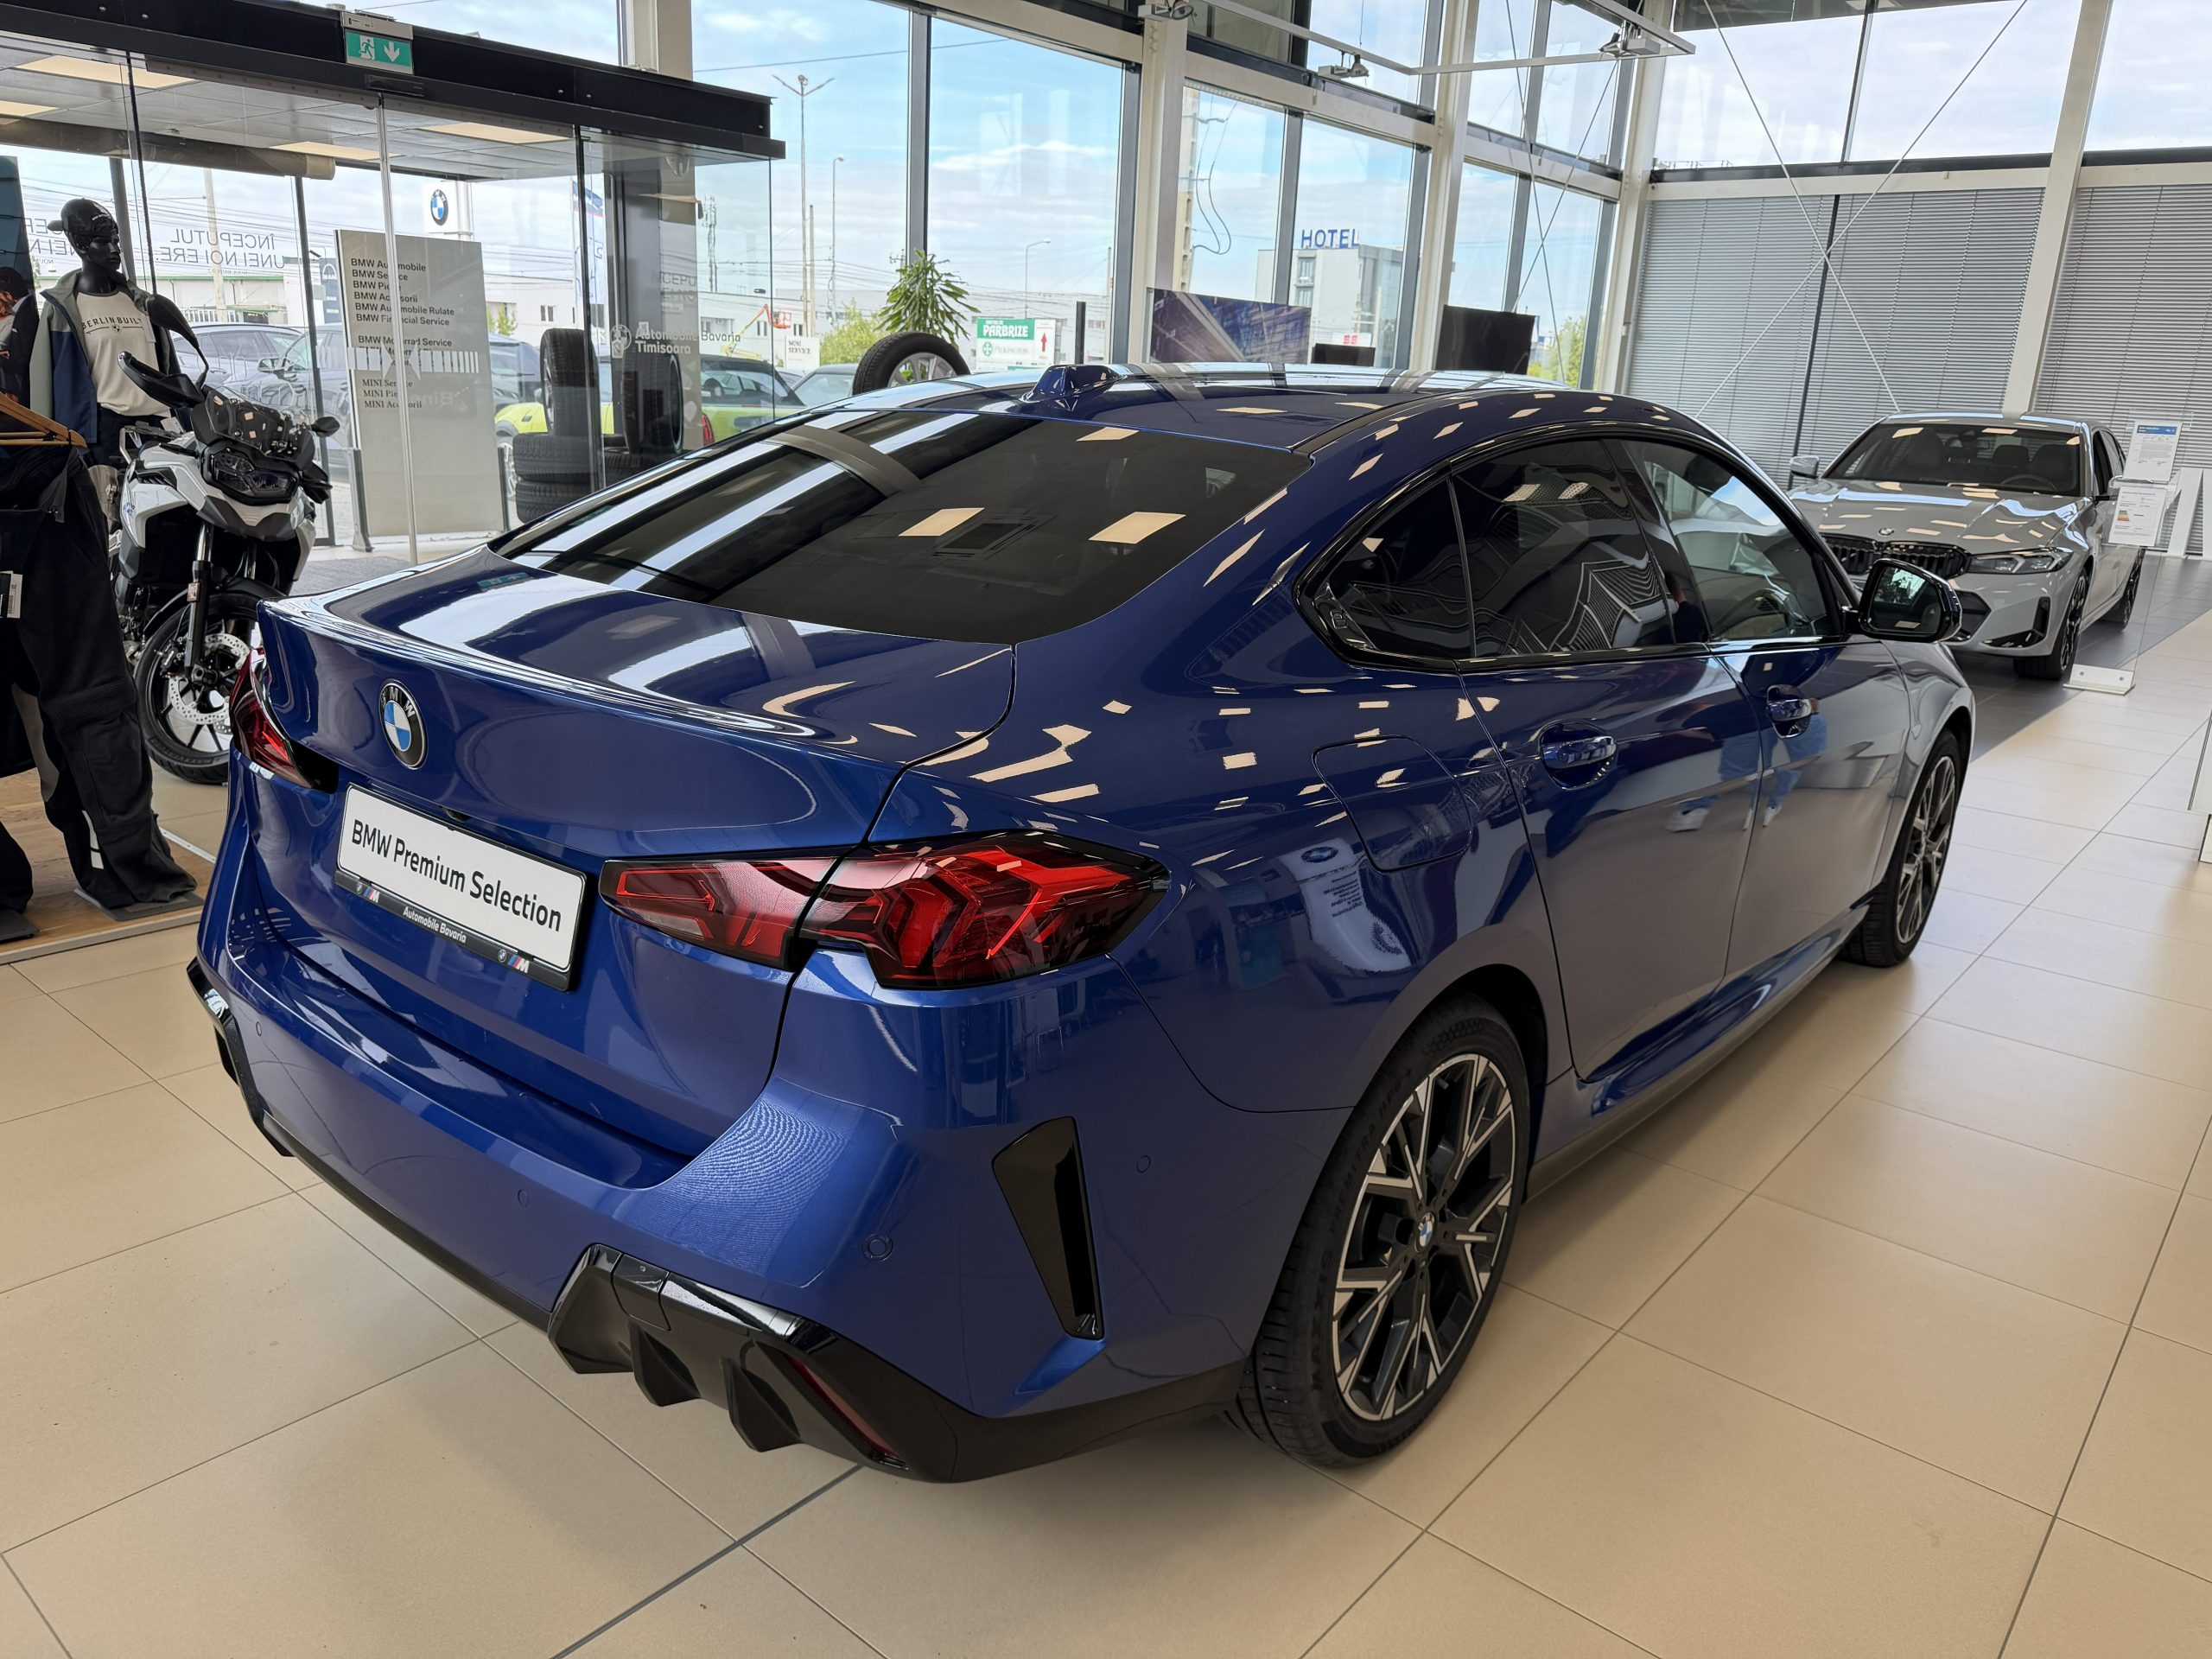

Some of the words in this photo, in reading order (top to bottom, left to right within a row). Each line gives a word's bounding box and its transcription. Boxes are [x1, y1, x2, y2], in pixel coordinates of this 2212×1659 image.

[1301, 228, 1360, 249] HOTEL
[351, 258, 374, 268] BMW
[377, 261, 426, 271] Aumobile
[352, 270, 375, 279] BMW
[377, 271, 408, 281] Sece
[353, 281, 376, 289] BMW
[354, 291, 377, 301] BMW
[379, 293, 417, 302] Acsorii
[355, 302, 378, 312] BMW
[380, 304, 427, 315] Aumobile
[82, 317, 116, 329] BERLIN
[356, 314, 378, 322] BMW
[381, 315, 418, 324] Ficial
[420, 316, 449, 326] Service
[702, 330, 741, 342] Bavaria
[982, 324, 1028, 338] PARBRIZE
[358, 335, 381, 344] BMW
[383, 336, 421, 346] Morrad
[423, 338, 452, 346] Service
[635, 340, 691, 354] Timisoara
[352, 819, 392, 857] BMW
[393, 838, 466, 892] Premium
[469, 870, 562, 931] Selection
[403, 906, 439, 932] Automobile
[440, 924, 467, 944] Bavaria
